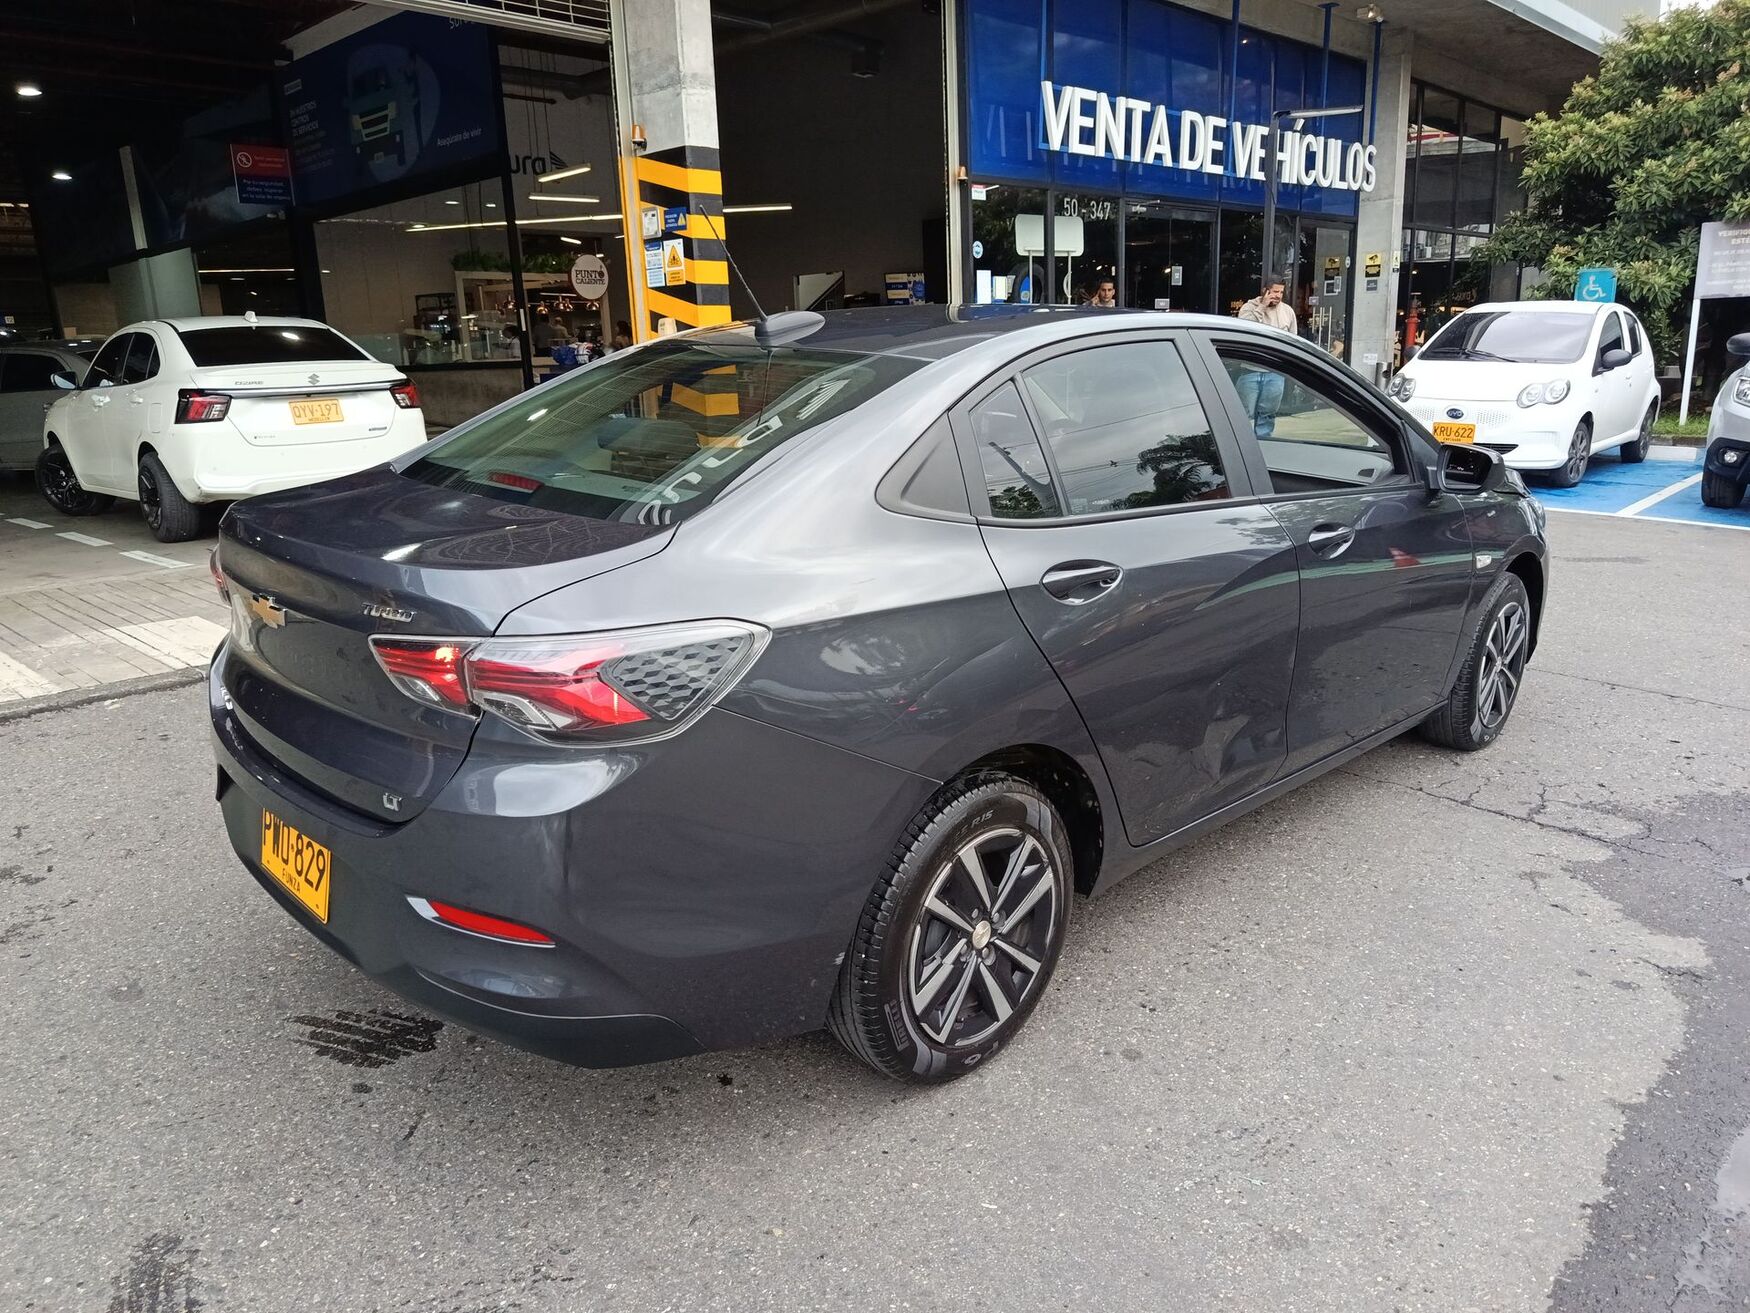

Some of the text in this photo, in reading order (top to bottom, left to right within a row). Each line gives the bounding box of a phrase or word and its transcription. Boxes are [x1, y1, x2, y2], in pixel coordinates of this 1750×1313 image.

[1041, 80, 1377, 192] VENTA DE VEHÍCULOS
[1063, 197, 1079, 218] 50
[1089, 200, 1112, 221] 347
[575, 265, 605, 279] PUNTO
[383, 792, 402, 812] LT
[282, 868, 301, 894] FUNZA
